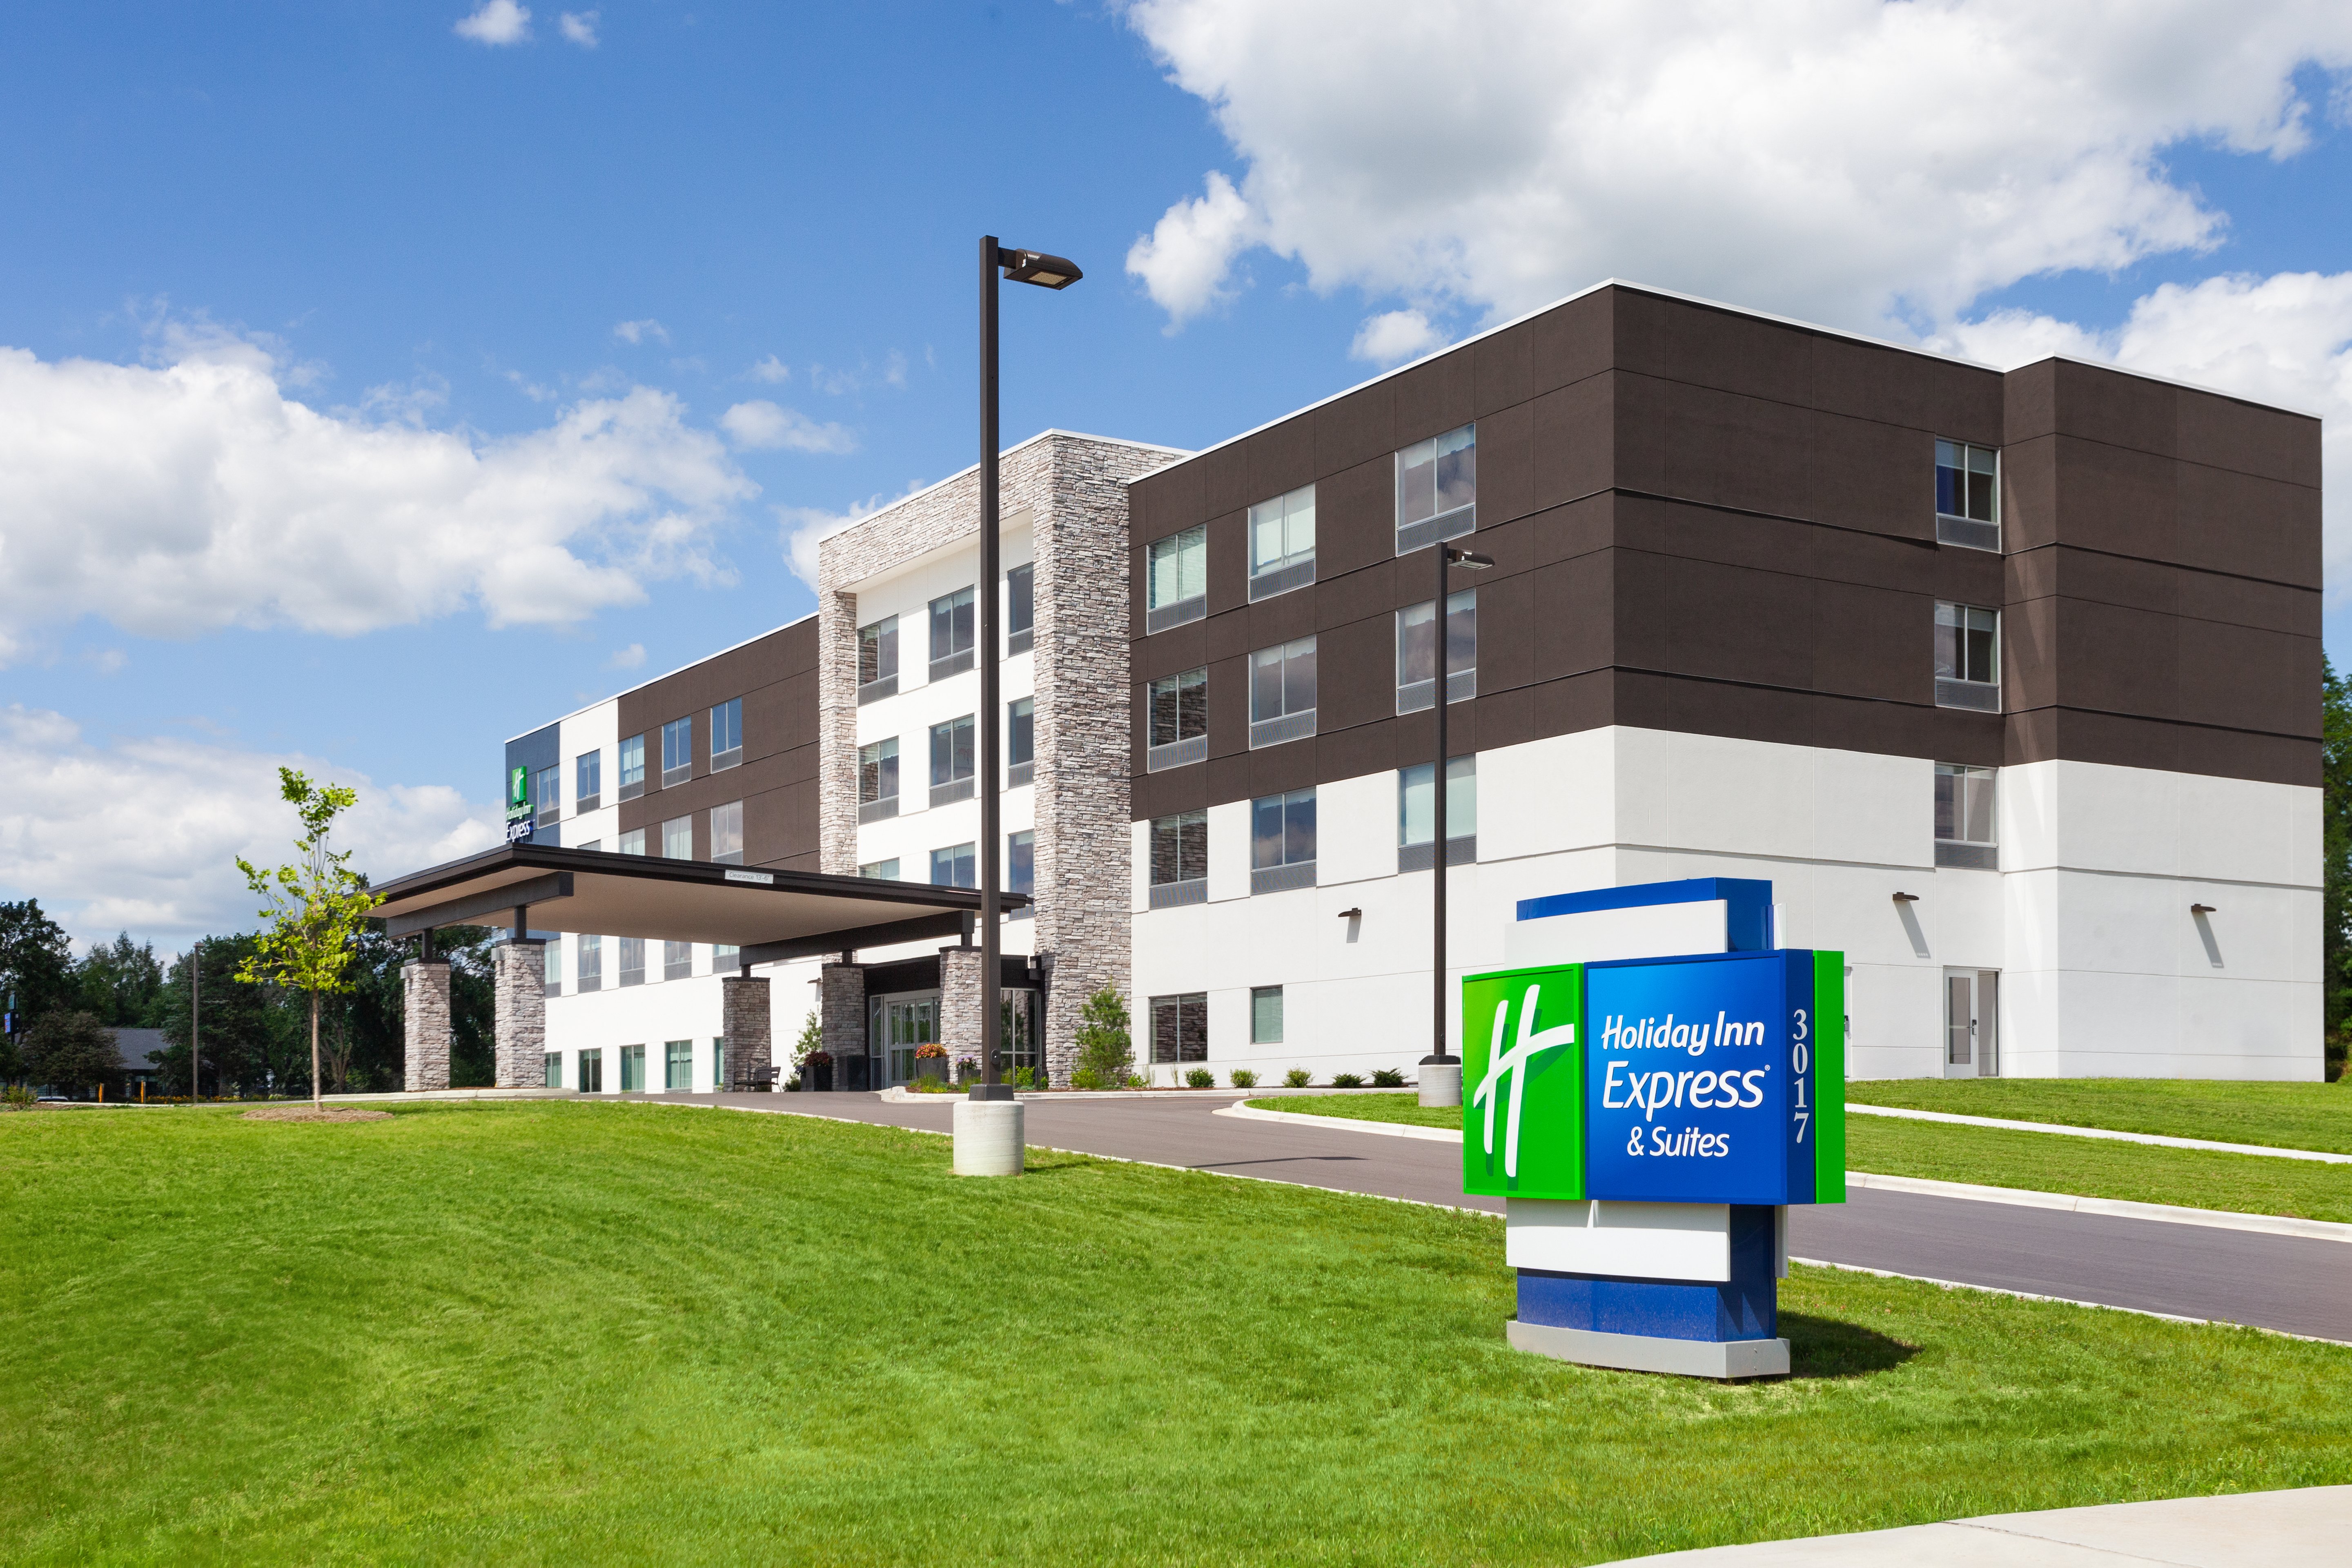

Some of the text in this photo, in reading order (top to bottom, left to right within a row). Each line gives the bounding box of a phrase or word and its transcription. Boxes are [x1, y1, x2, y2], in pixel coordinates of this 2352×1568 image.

[506, 801, 531, 821] Holiday Inn
[506, 820, 530, 842] Express
[1601, 1011, 1765, 1056] Holiday Inn
[1793, 1009, 1809, 1143] 3017
[1627, 1126, 1730, 1157] & Suites
